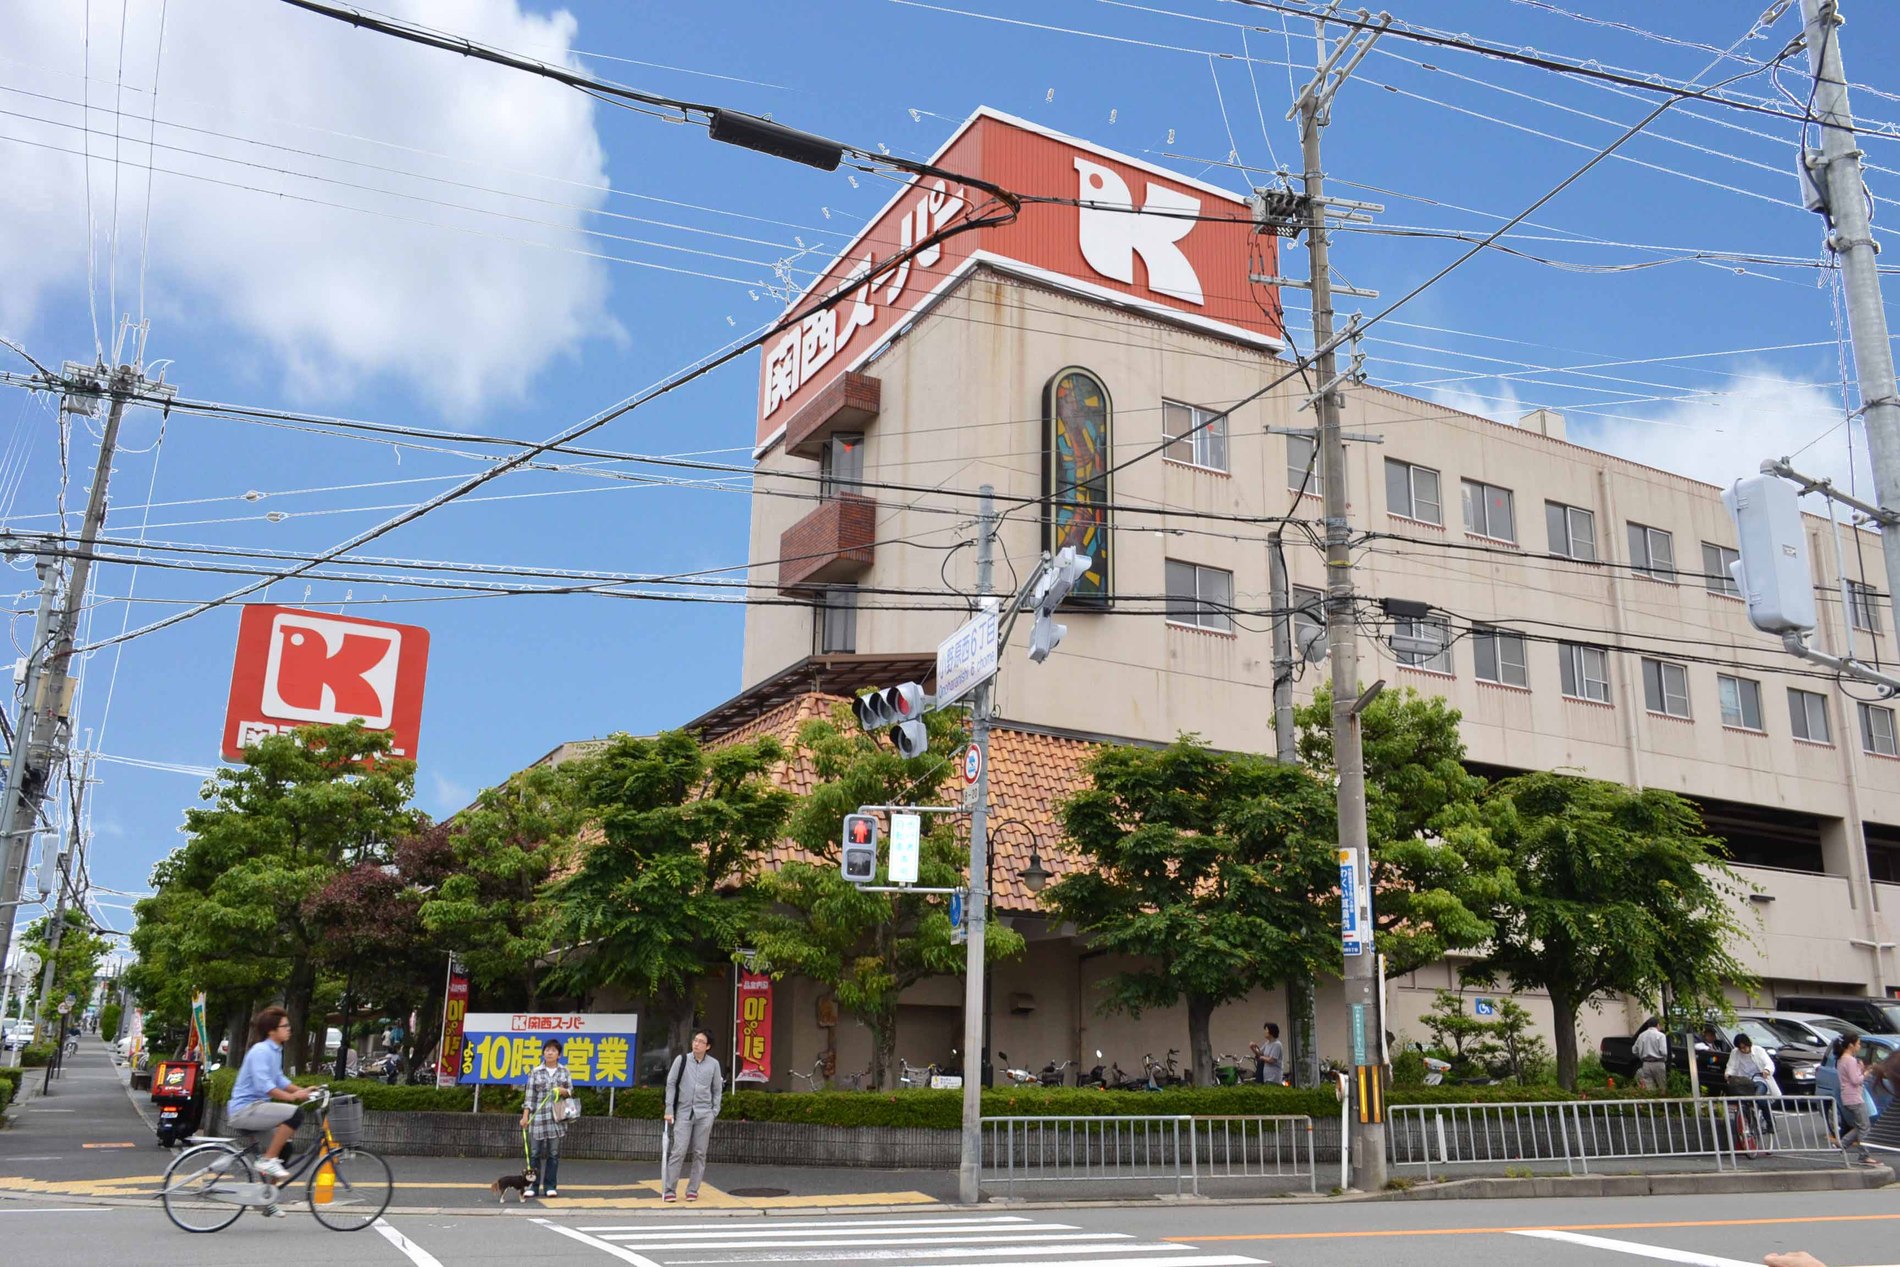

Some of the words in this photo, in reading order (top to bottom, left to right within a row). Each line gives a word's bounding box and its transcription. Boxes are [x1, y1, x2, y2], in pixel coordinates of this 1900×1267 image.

[527, 1016, 586, 1030] 関西スーパー
[461, 1040, 475, 1075] よる
